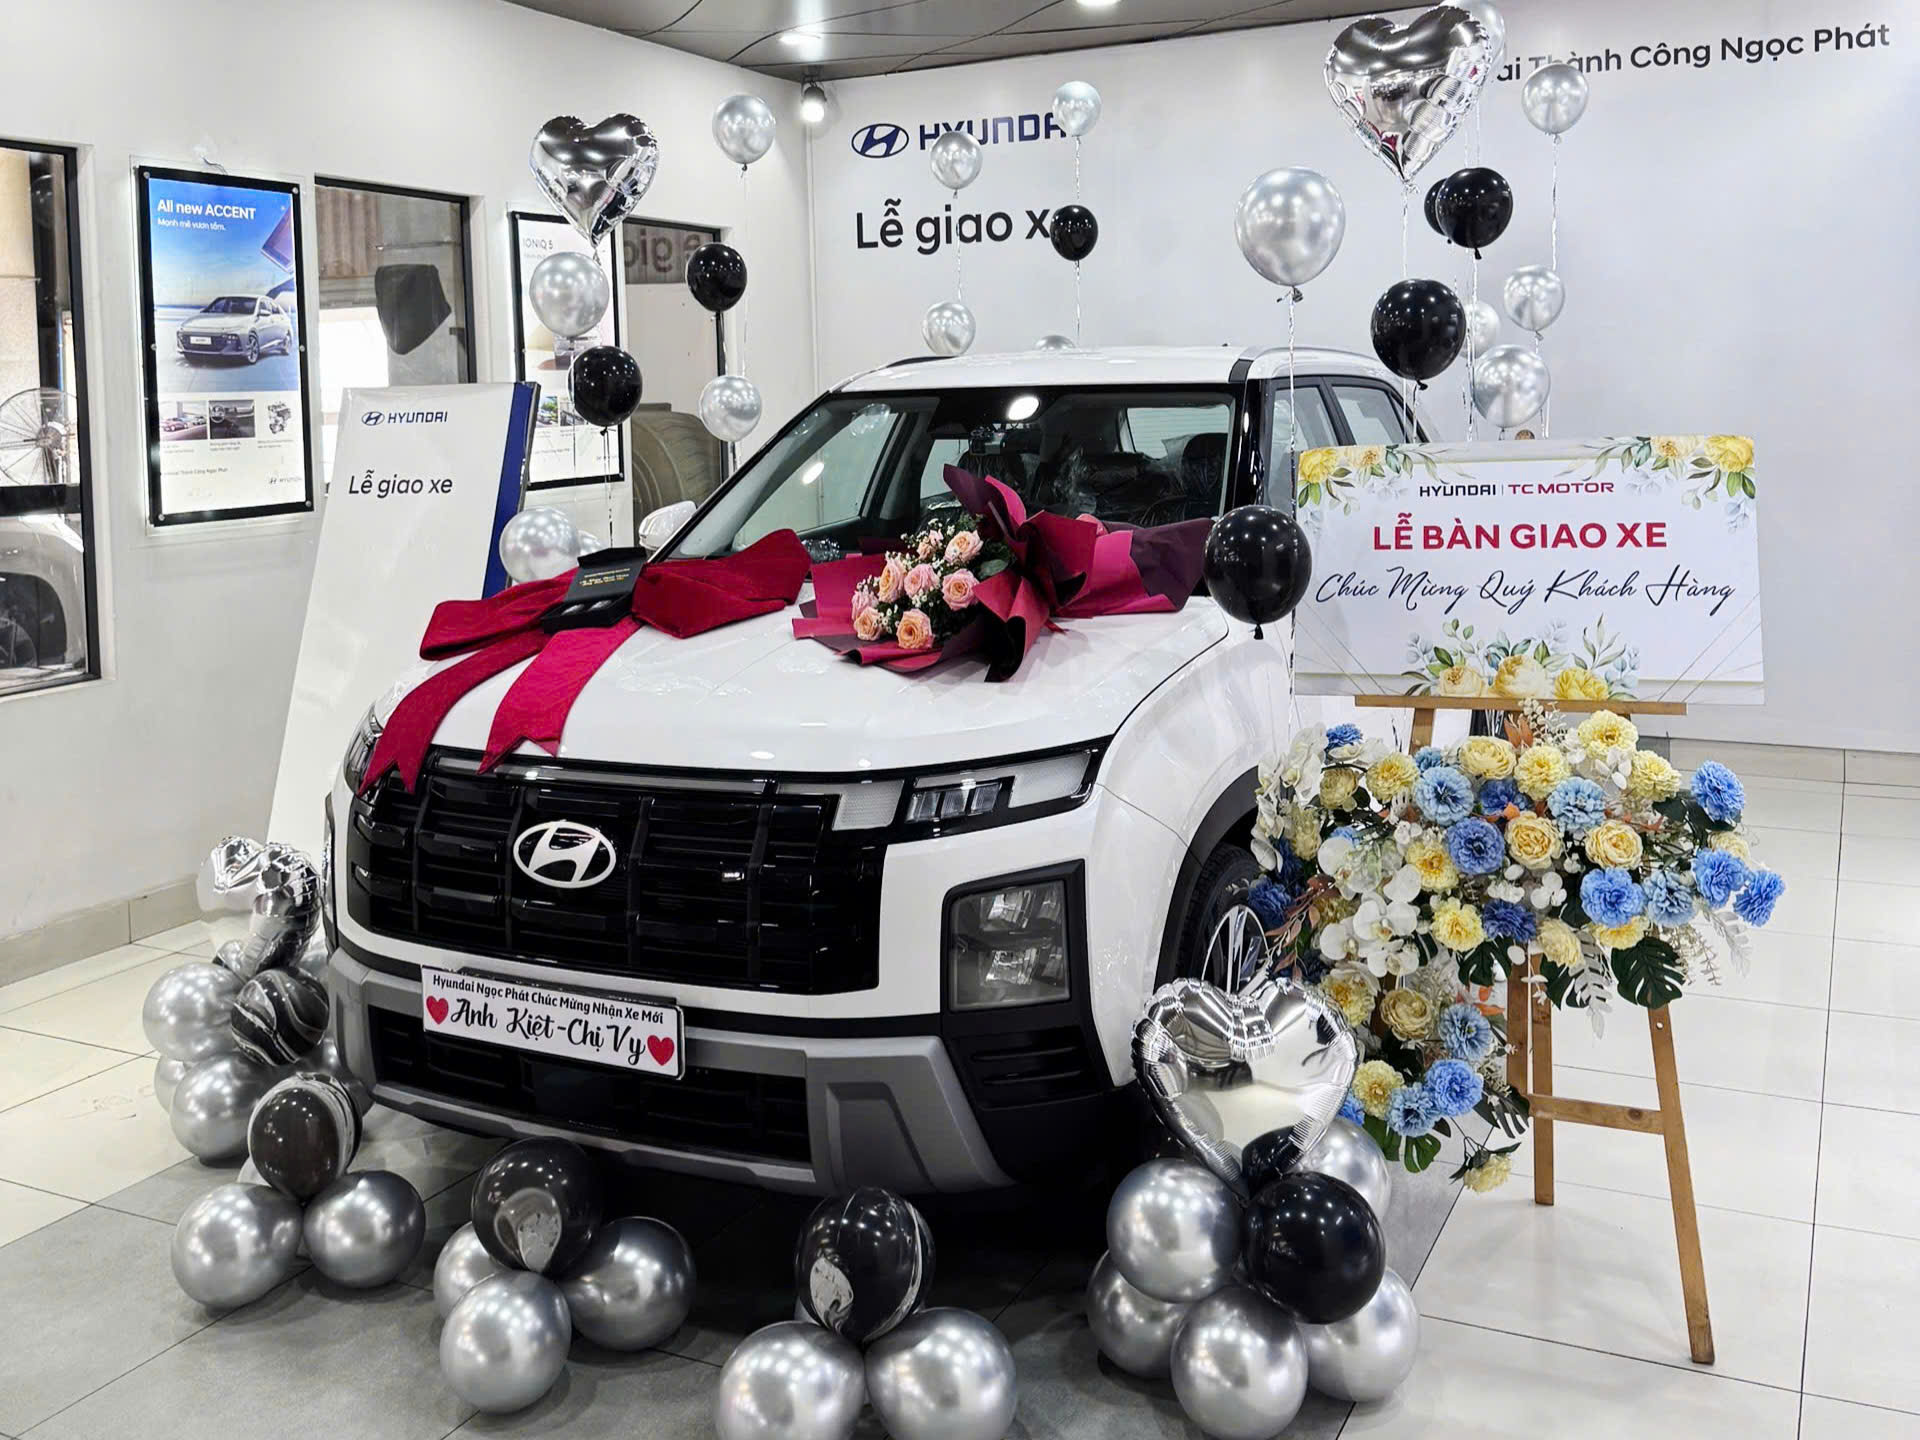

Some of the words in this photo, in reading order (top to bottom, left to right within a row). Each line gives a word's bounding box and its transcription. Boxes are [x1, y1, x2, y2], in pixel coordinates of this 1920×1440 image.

[1630, 42, 1711, 68] Công
[1721, 37, 1804, 63] Ngọc
[1814, 23, 1890, 52] Phát
[157, 199, 173, 213] All
[176, 203, 202, 215] new
[205, 203, 256, 220] ACCENT
[856, 198, 904, 248] Lễ
[916, 204, 1013, 255] giao
[1025, 209, 1050, 240] x
[387, 411, 448, 423] HYUNDAI
[349, 469, 375, 494] Lễ
[377, 474, 423, 499] giao
[428, 478, 453, 494] xe
[1419, 484, 1496, 497] HYUNDAI
[1508, 484, 1534, 494] TC
[1538, 482, 1614, 494] MOTOR
[1373, 512, 1414, 550] LỄ
[1423, 518, 1500, 549] BÀN
[1510, 523, 1607, 549] GIAO
[1616, 522, 1667, 548] XE
[1316, 571, 1379, 603] Chúc
[1386, 566, 1469, 615] Mừng
[1477, 570, 1537, 615] Quý
[1544, 569, 1640, 603] Khách
[1645, 564, 1736, 616] Hàng
[433, 974, 474, 993] Hyundai
[476, 982, 503, 999] Ngọc
[505, 987, 529, 1002] Phát
[531, 992, 558, 1007] Chúc
[592, 1002, 623, 1019] Nhận
[625, 1007, 639, 1020] Xe
[641, 1010, 663, 1024] Mới
[451, 998, 498, 1029] Anh
[606, 1025, 646, 1066] Vy
